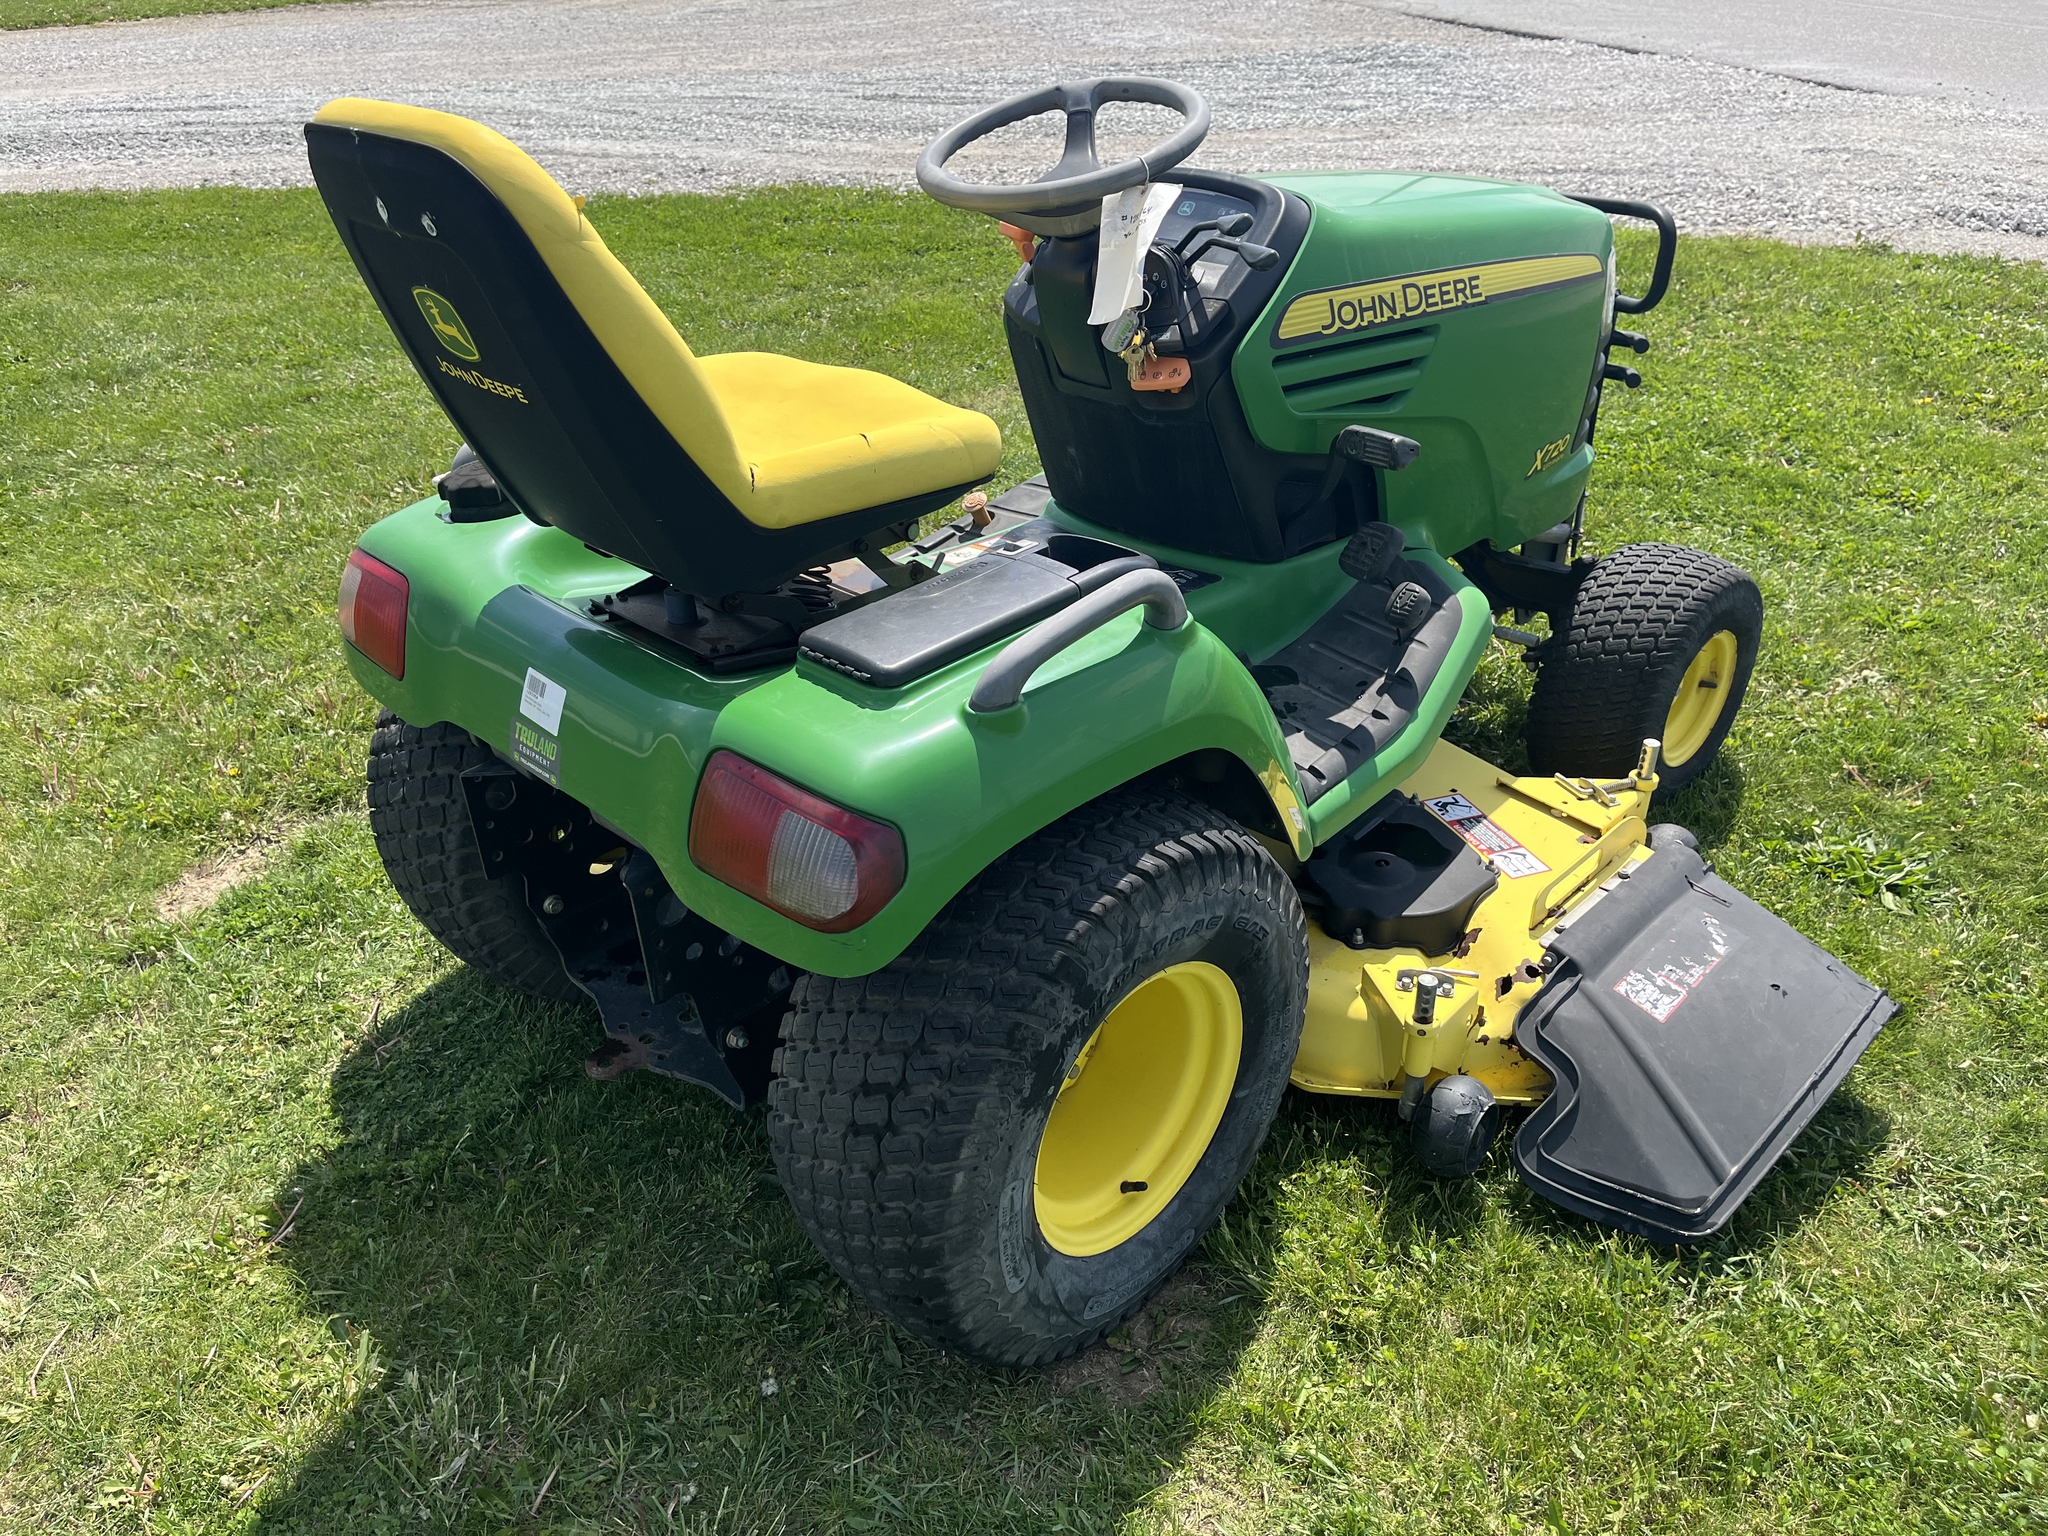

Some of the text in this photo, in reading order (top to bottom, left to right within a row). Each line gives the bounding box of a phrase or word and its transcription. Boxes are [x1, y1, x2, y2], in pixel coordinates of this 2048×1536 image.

[1321, 274, 1484, 331] JOHN DEERE
[435, 355, 478, 387] JOHN
[1526, 432, 1571, 477] X720
[515, 721, 557, 761] TRULAND
[519, 743, 550, 768] EQUIPMENT
